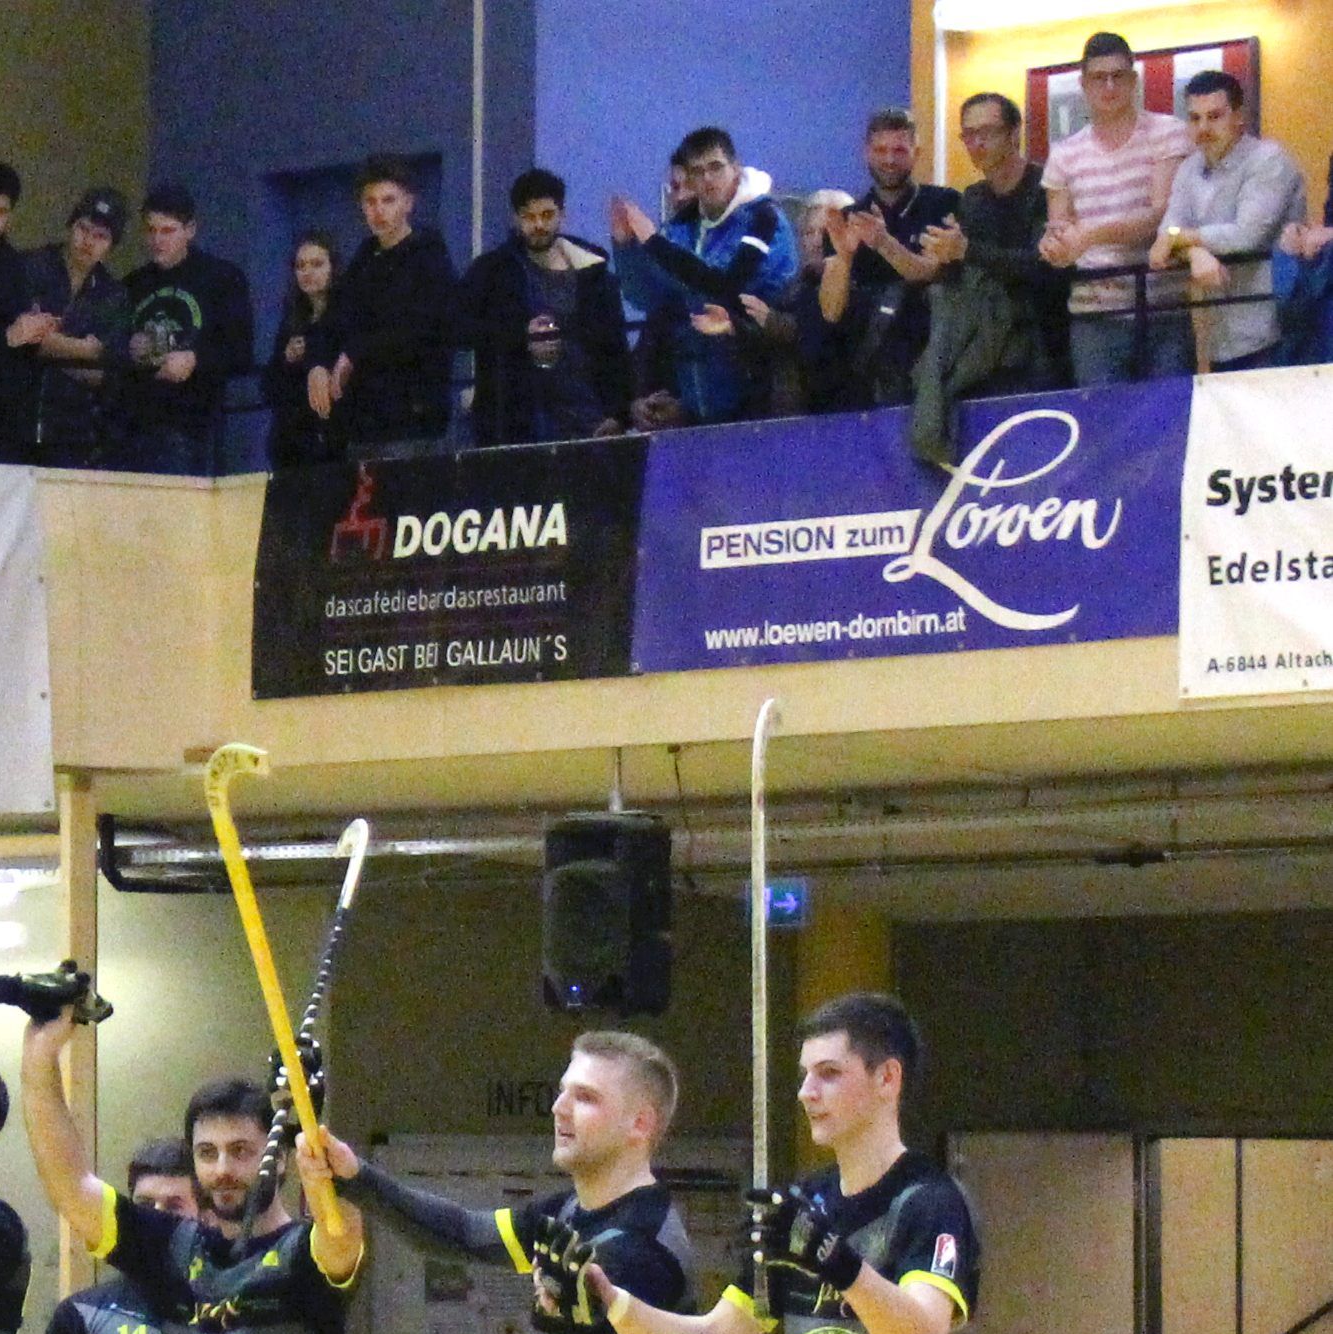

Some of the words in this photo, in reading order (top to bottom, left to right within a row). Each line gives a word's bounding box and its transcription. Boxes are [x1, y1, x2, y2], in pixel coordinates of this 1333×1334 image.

[393, 502, 566, 559] DOGANA
[707, 526, 834, 560] PENSION
[846, 525, 905, 549] zum
[704, 606, 967, 650] www.loewen-dornbirn.at
[325, 650, 353, 676] SEI
[358, 644, 409, 674] GAST
[415, 643, 439, 669] BEI
[1207, 654, 1267, 674] A-6844
[1275, 650, 1333, 669] Altach
